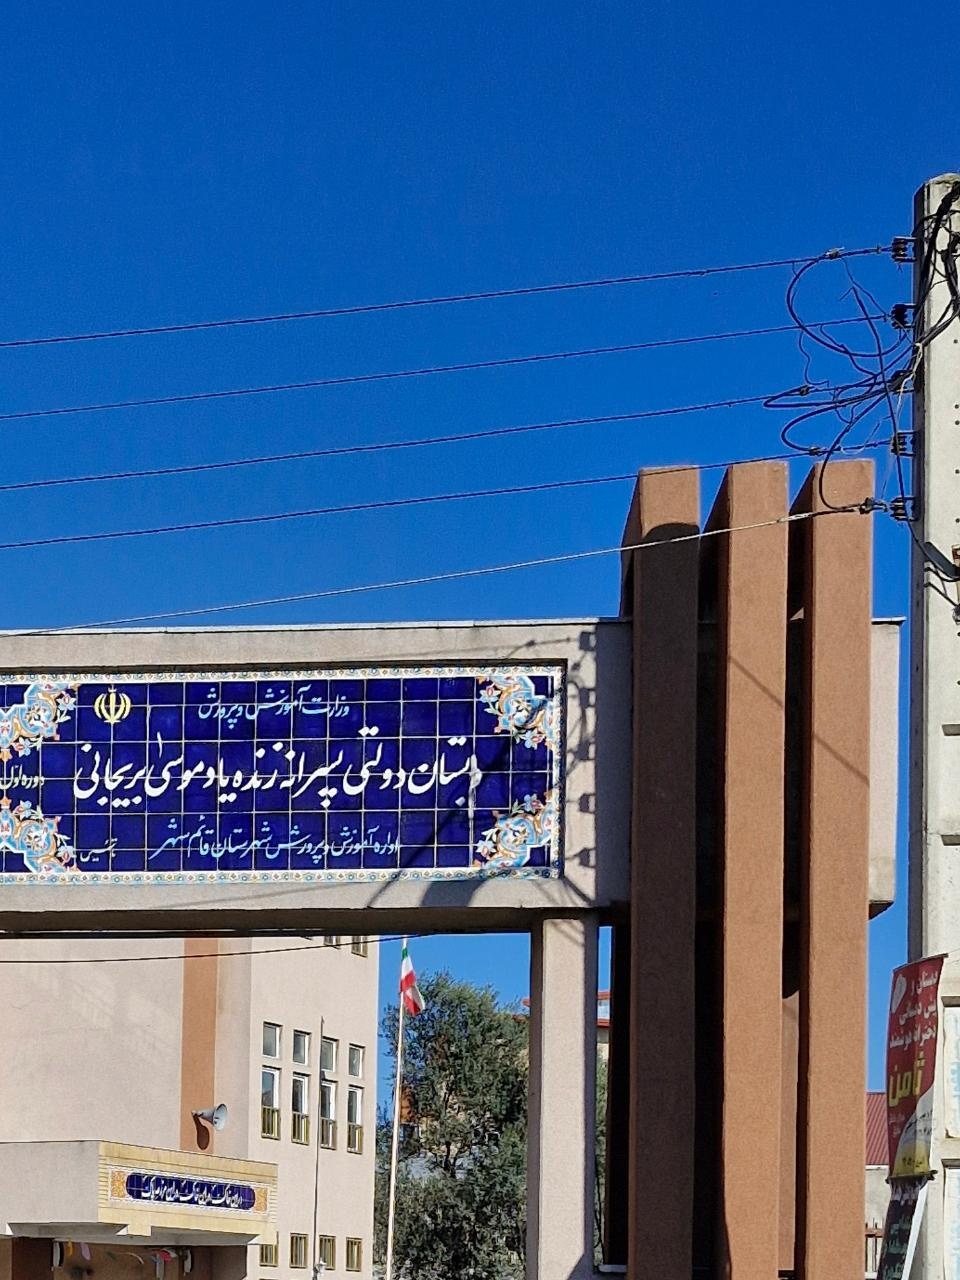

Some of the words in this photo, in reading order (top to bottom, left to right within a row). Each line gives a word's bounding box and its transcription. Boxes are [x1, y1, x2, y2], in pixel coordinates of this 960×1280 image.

[198, 688, 239, 729] پرورش
[245, 684, 312, 720] آموزش
[302, 693, 350, 718] وزارت
[202, 757, 237, 803] یاد
[232, 741, 283, 791] زنده
[279, 747, 344, 808] پسرانه
[342, 725, 406, 796] دولتی
[407, 736, 483, 807] دبستان
[21, 774, 45, 790] دوره
[211, 821, 274, 859] شهرستان
[265, 825, 324, 864] پرورش
[332, 825, 380, 857] آموزش
[374, 831, 400, 855] اداره
